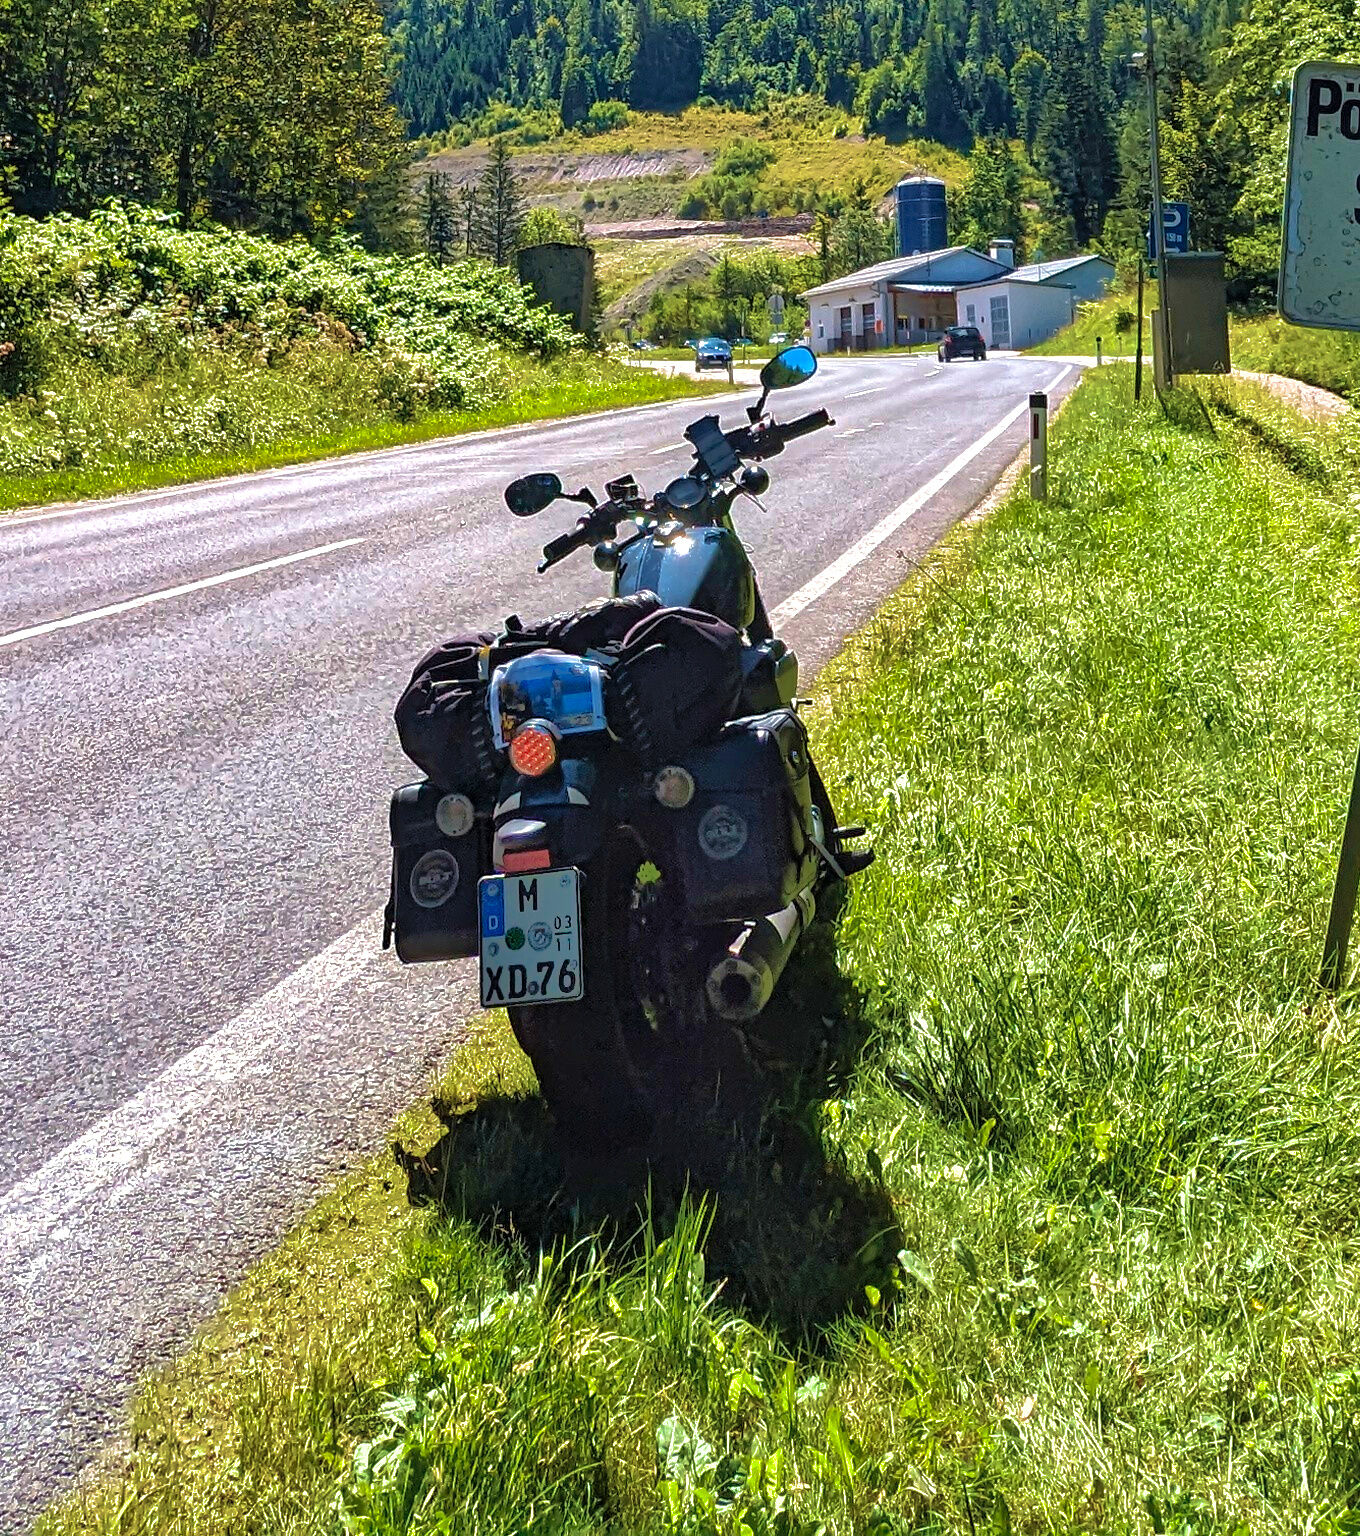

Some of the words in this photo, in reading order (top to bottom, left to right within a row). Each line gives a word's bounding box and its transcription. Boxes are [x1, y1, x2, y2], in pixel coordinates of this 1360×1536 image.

[518, 878, 538, 913] M
[488, 915, 499, 931] D
[554, 915, 572, 930] 03
